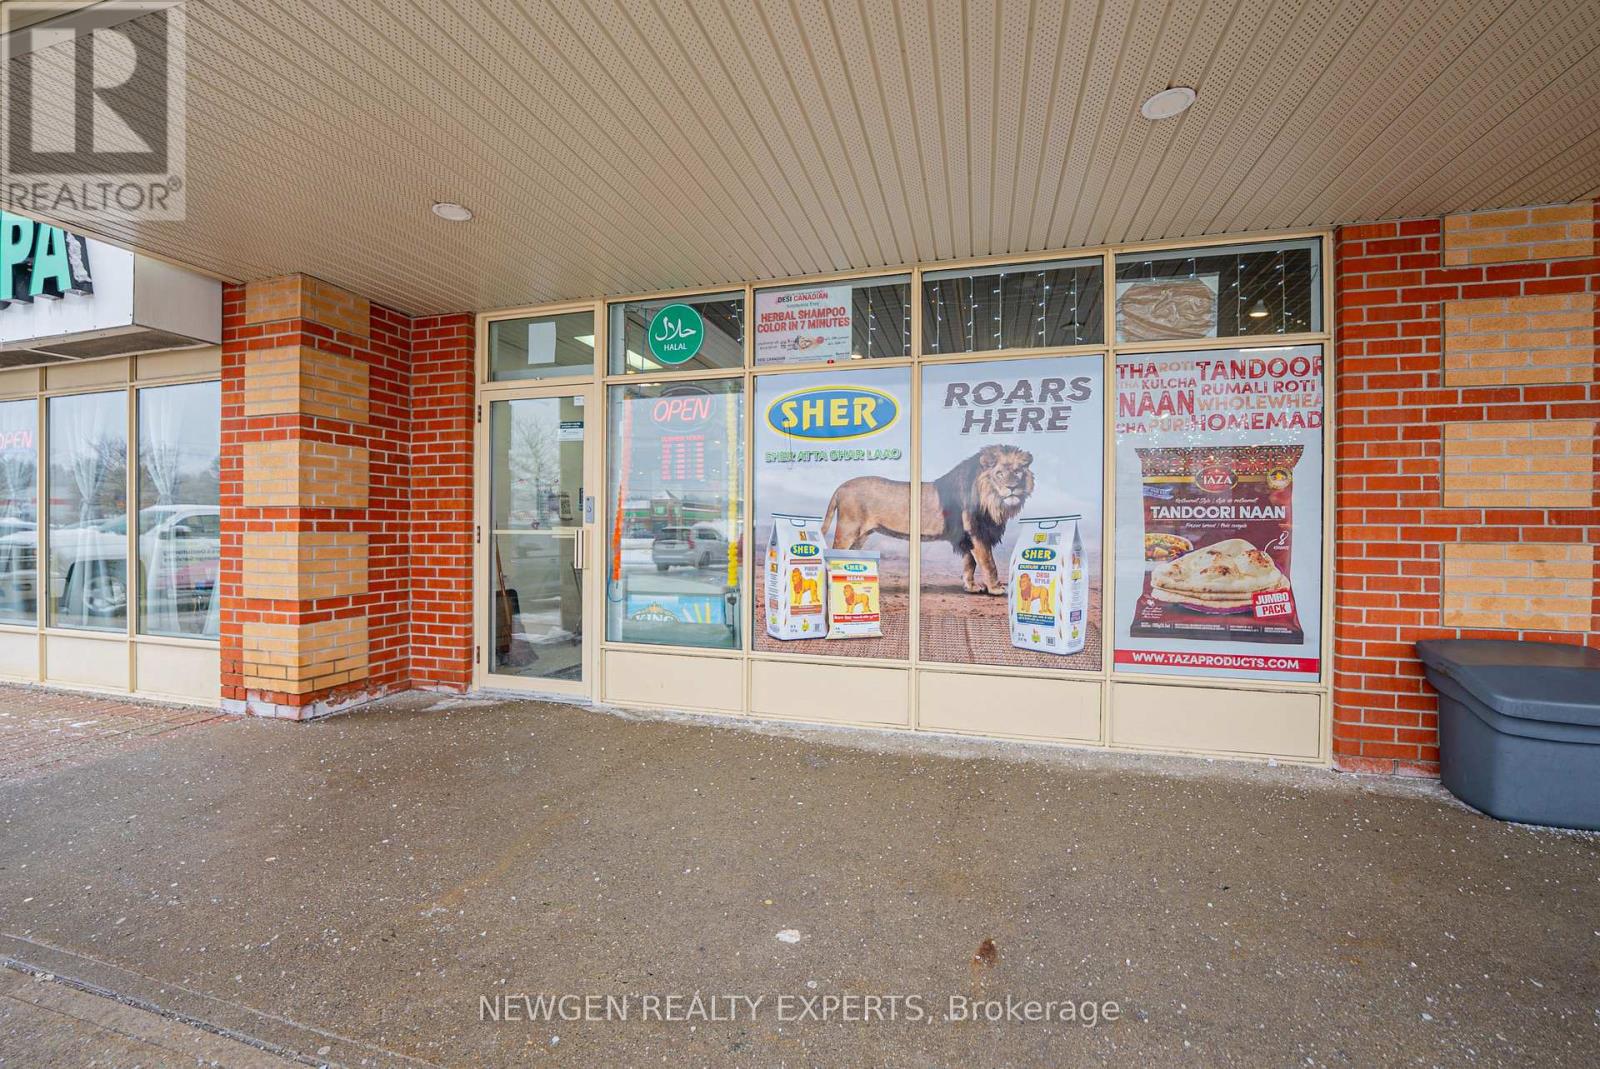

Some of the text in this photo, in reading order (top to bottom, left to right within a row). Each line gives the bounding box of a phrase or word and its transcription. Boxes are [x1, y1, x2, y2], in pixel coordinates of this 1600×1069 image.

[793, 292, 829, 302] CANADIAN
[761, 307, 846, 323] HERBAL SHAMPOO
[655, 316, 697, 341] حلال
[757, 317, 850, 334] COLOR IN 7 MINUTES
[663, 343, 688, 351] HALAL
[944, 376, 1092, 407] ROARS
[1142, 377, 1198, 390] KULCHA
[1202, 381, 1268, 396] RUMALI
[1273, 379, 1316, 393] ROTI
[653, 396, 712, 423] OPEN
[1119, 389, 1195, 418] NAAN
[781, 397, 878, 431] SHER
[961, 406, 1072, 433] HERE
[797, 450, 828, 462] ATTA
[1202, 475, 1233, 486] TAZA
[1150, 505, 1286, 519] TANDOORI NAAN
[793, 545, 816, 555] SHER
[1024, 549, 1052, 559] SHER
[1255, 592, 1290, 605] JUMBO
[1262, 604, 1287, 616] PACK
[1132, 652, 1300, 669] WWW.TAZAPRODUCTS.COM
